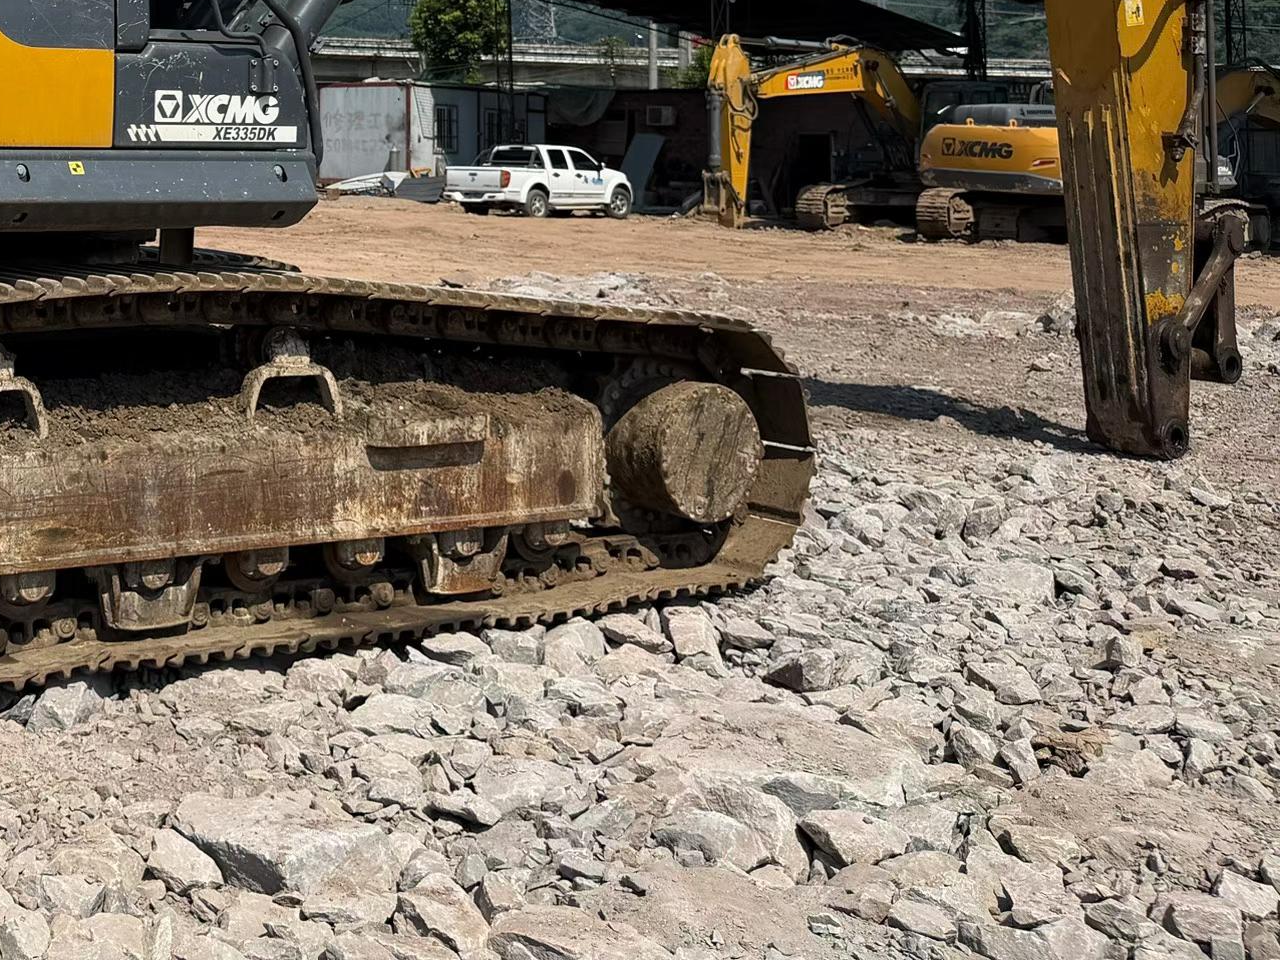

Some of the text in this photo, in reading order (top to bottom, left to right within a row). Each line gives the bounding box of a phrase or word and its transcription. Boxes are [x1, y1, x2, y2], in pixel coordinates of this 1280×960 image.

[182, 94, 280, 124] XCMG
[212, 126, 278, 141] XE335DK
[955, 140, 1014, 159] XCMG
